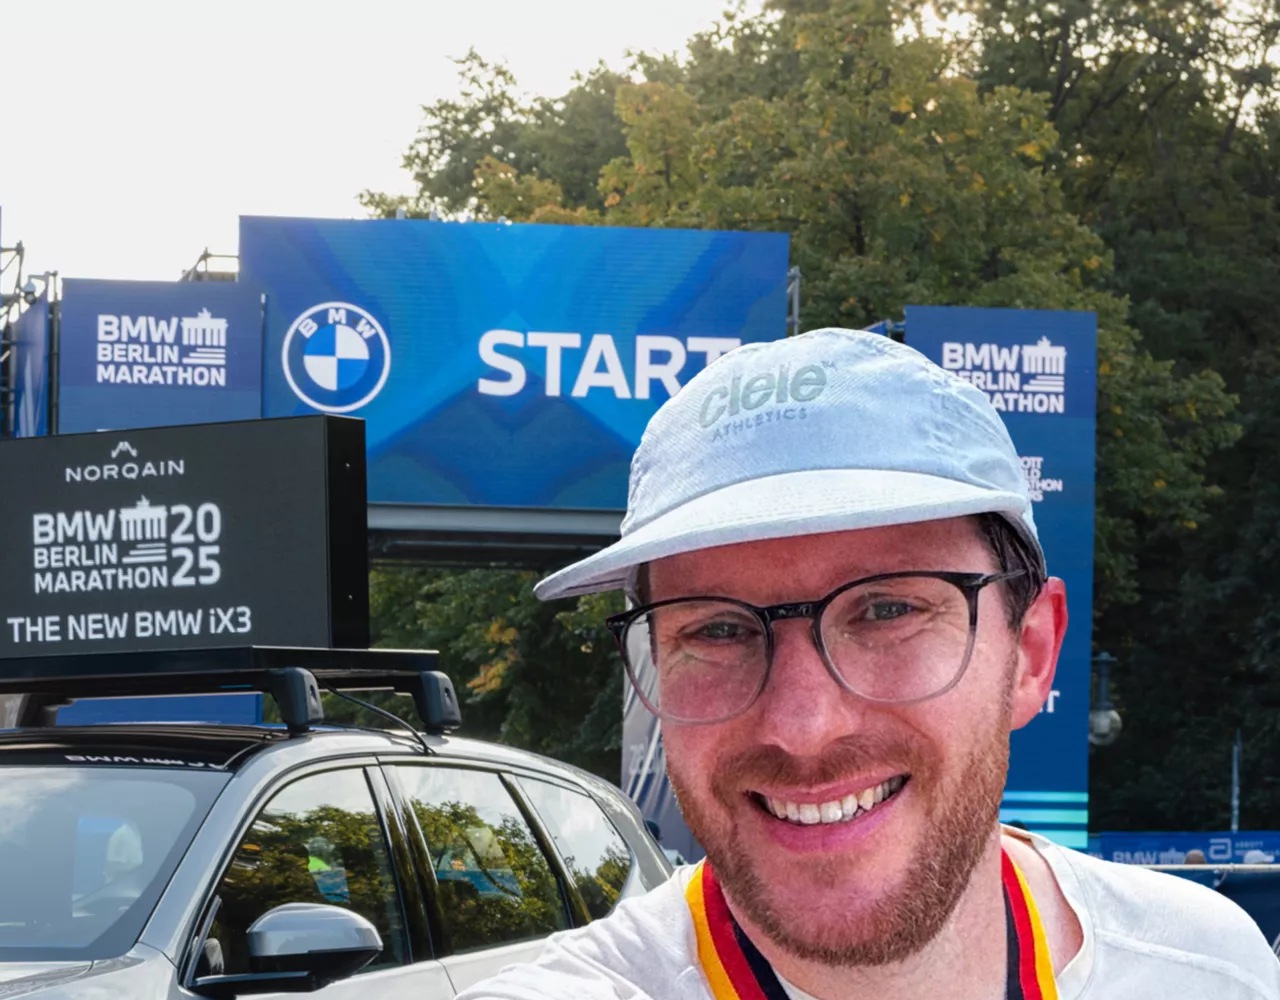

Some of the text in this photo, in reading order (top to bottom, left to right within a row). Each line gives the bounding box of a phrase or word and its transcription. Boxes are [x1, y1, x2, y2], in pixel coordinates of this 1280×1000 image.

[97, 314, 179, 343] BMW
[298, 308, 376, 340] BMW
[97, 343, 179, 365] BERLIN
[478, 329, 741, 399] START
[942, 342, 1020, 371] BMW
[96, 364, 226, 387] MARATHON
[950, 370, 1020, 392] ERLIN
[712, 407, 807, 441] ATHLETICS
[65, 459, 185, 482] NORQAIN
[33, 509, 116, 545] BMW
[170, 503, 221, 544] 20
[34, 543, 118, 568] BERLIN
[171, 545, 221, 586] 25
[34, 566, 168, 594] MARATHON
[7, 606, 252, 643] THE NEW BMW iX3
